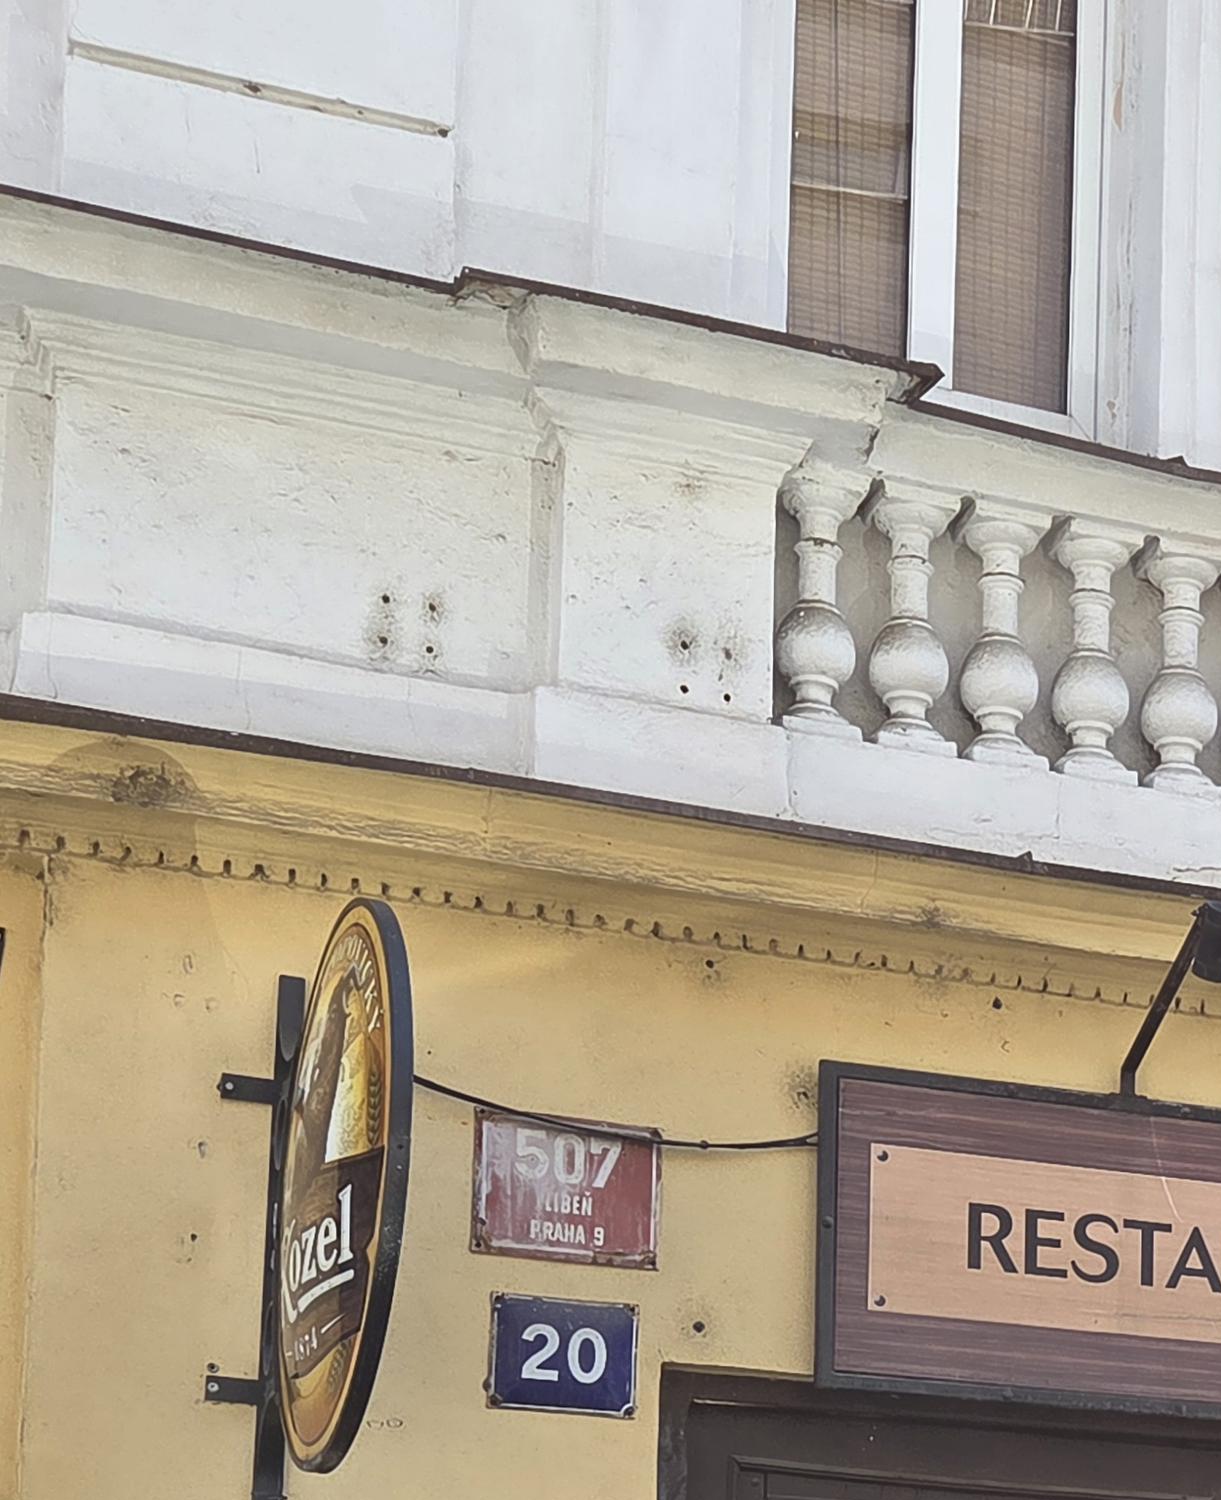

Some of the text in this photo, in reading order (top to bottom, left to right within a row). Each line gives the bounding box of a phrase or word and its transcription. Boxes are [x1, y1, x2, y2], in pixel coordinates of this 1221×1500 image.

[514, 1128, 623, 1189] 507
[544, 1191, 593, 1217] LIBEŇ
[529, 1219, 605, 1247] PRAHA 9
[521, 1323, 608, 1385] 20
